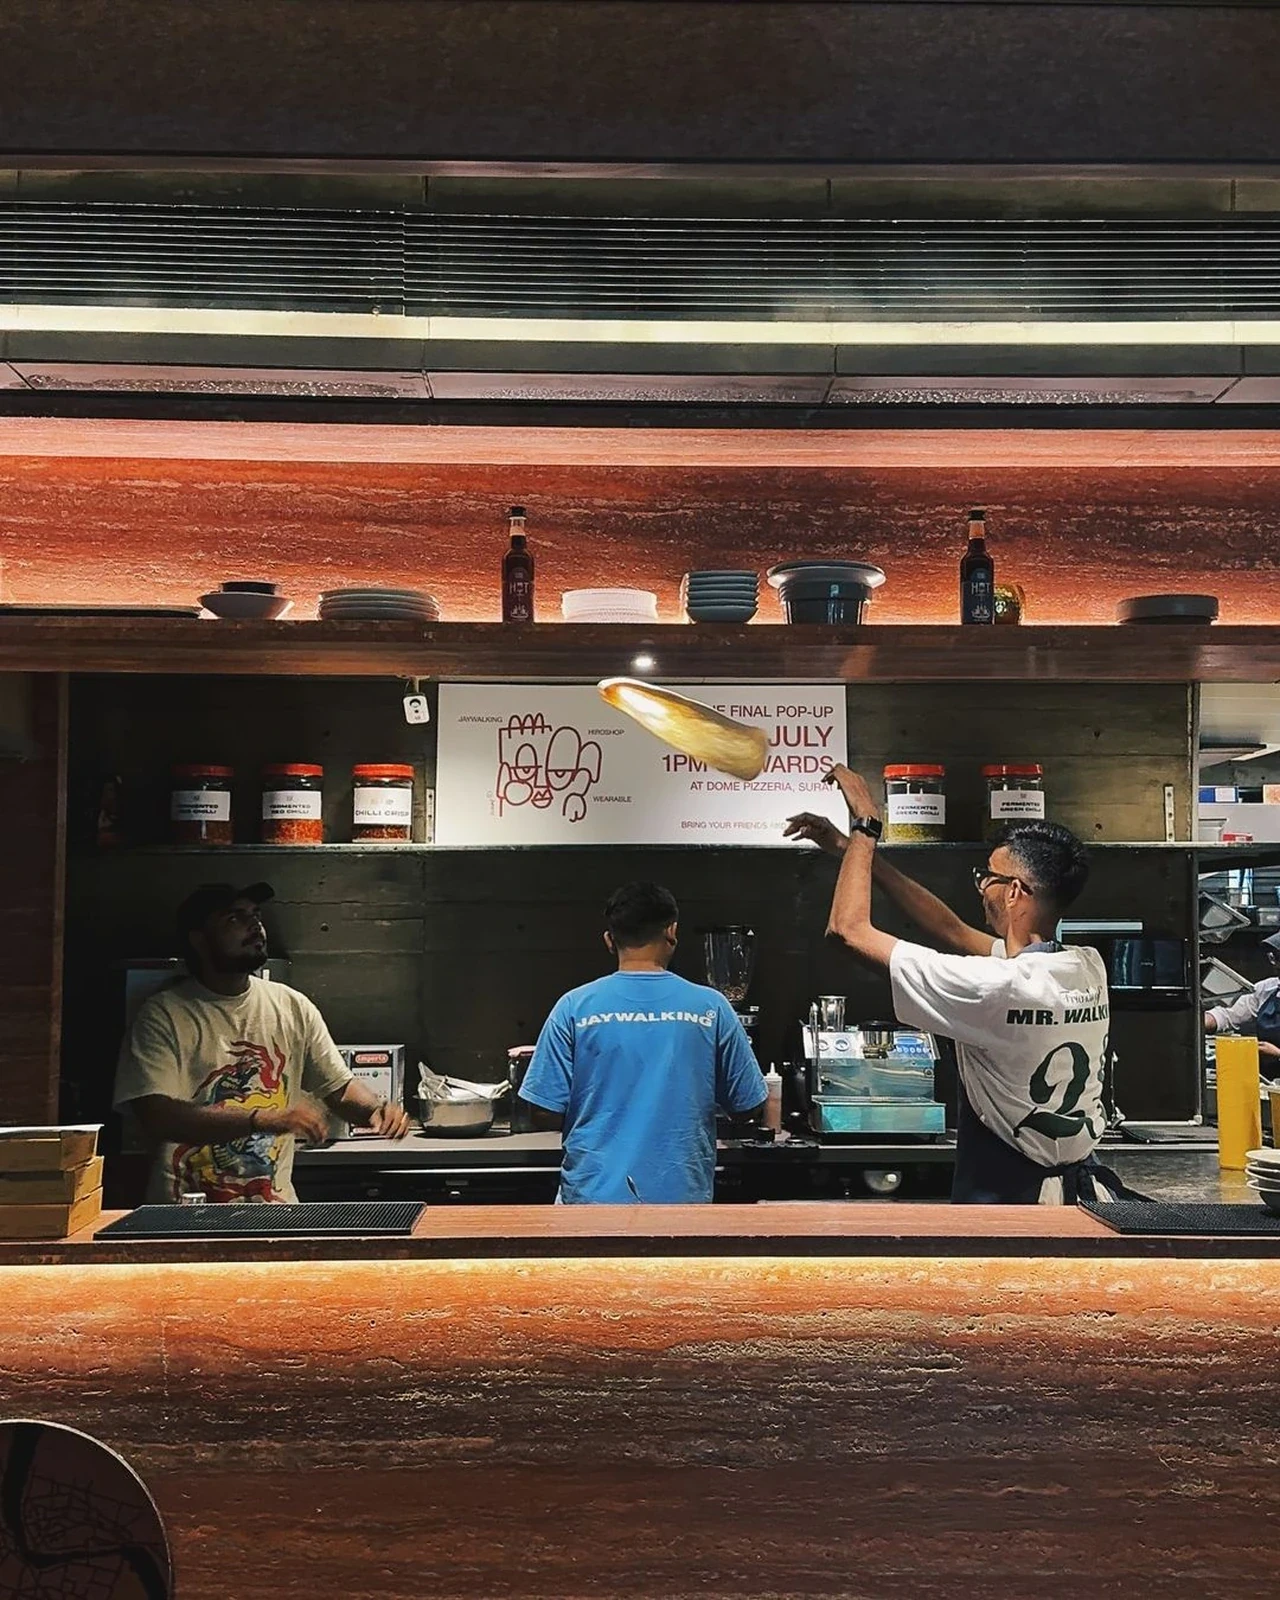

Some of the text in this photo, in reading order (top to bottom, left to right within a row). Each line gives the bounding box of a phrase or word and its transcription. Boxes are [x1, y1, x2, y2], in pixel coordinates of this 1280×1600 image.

[730, 705, 771, 718] FINAL
[777, 705, 833, 718] POP-UP
[458, 715, 503, 724] JAYWALKING
[768, 725, 833, 747] JULY
[662, 755, 708, 772] 1PM
[690, 782, 702, 791] AT
[706, 782, 740, 791] DOME
[743, 782, 795, 793] PIZZERIA,
[1006, 1009, 1059, 1025] MR.
